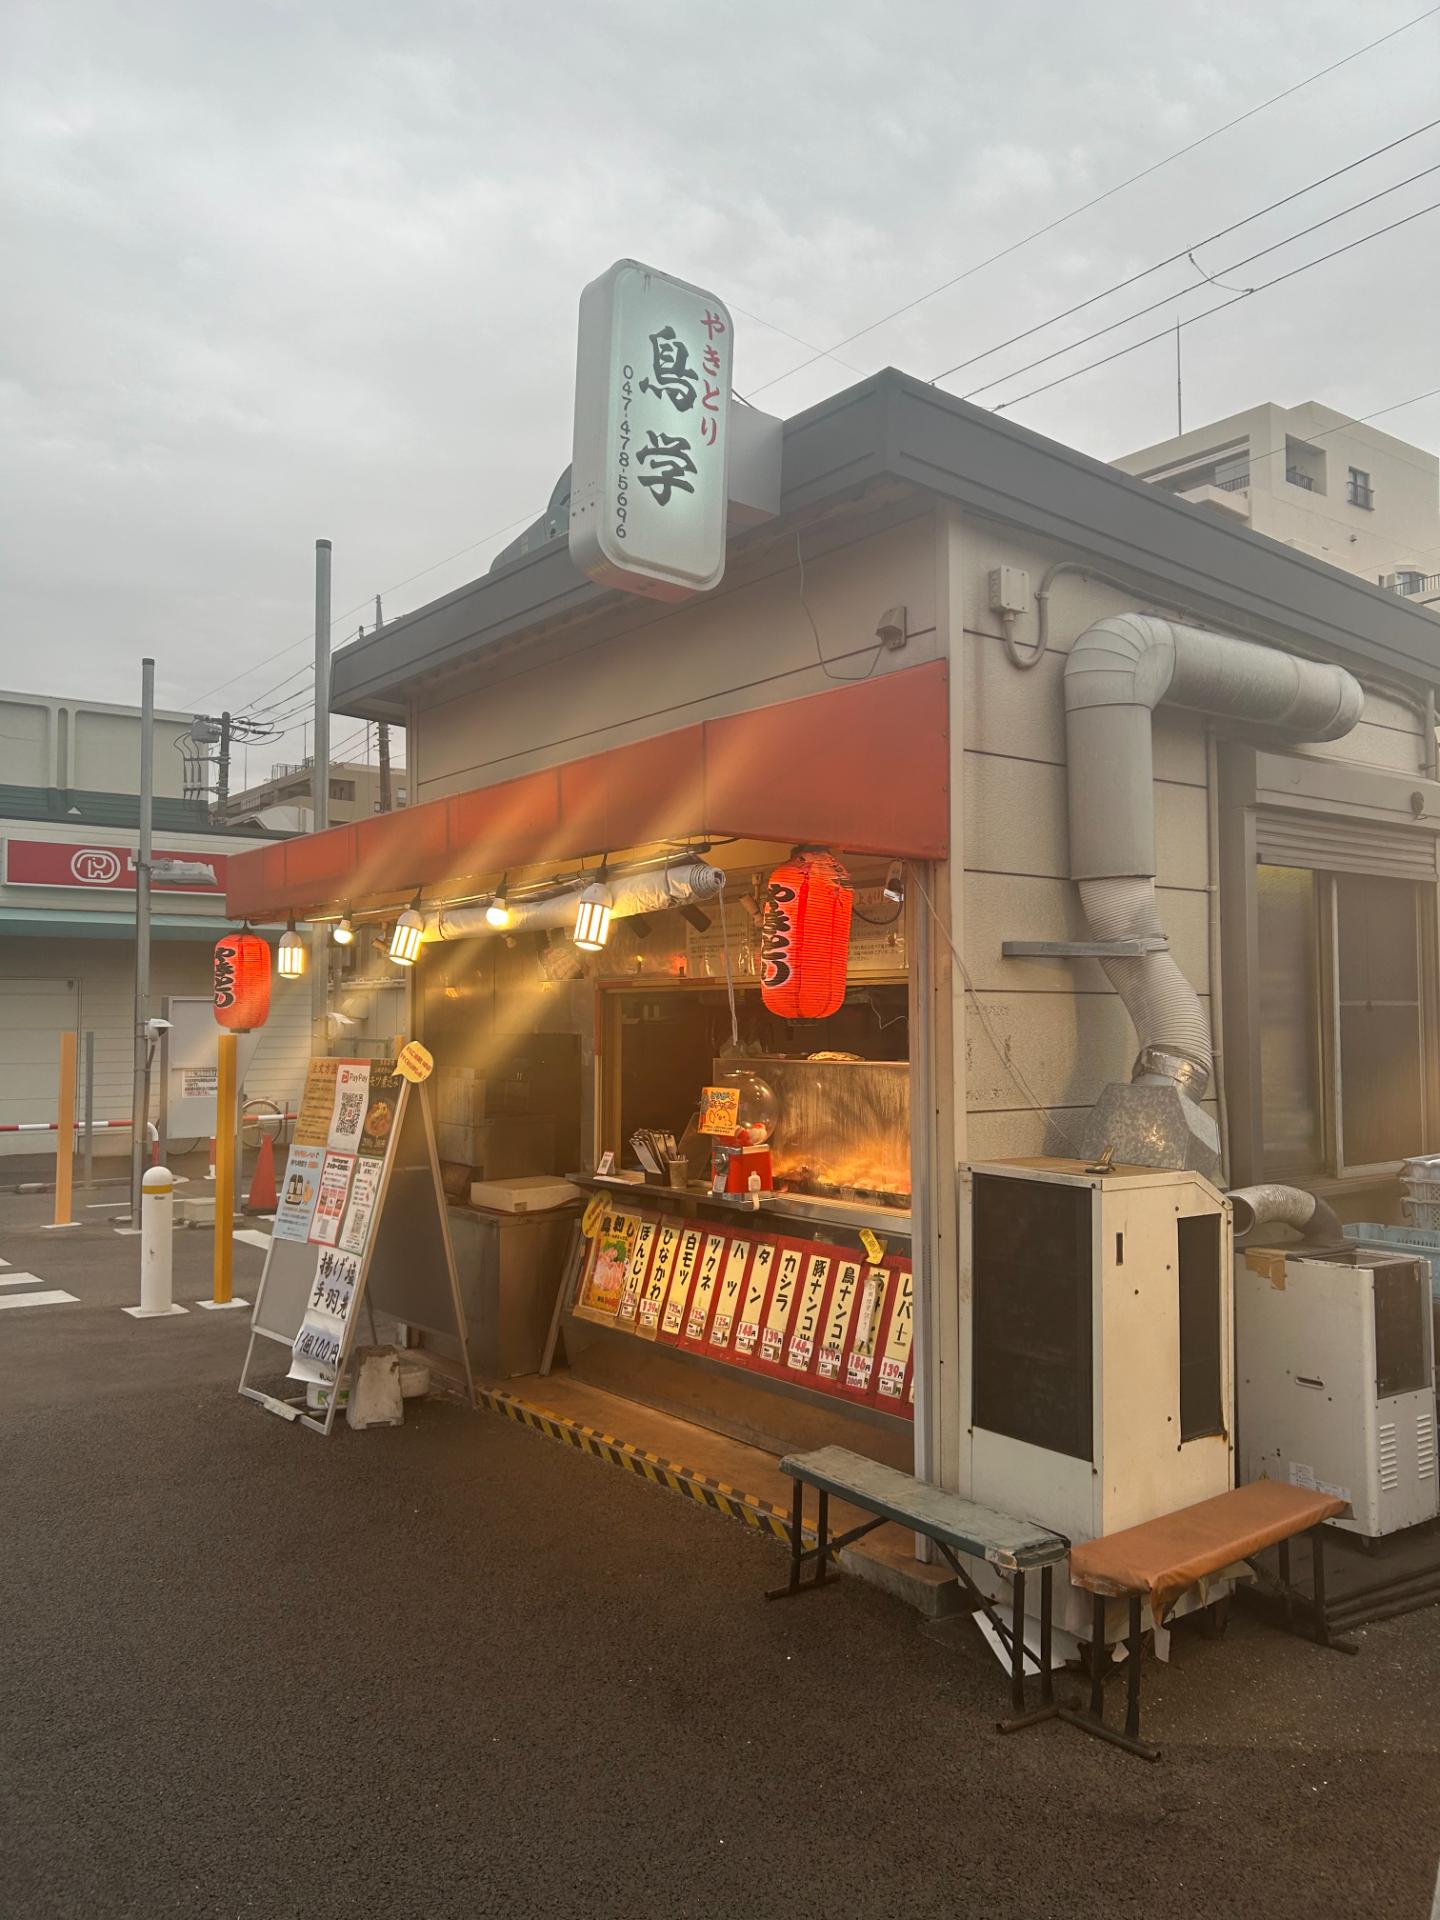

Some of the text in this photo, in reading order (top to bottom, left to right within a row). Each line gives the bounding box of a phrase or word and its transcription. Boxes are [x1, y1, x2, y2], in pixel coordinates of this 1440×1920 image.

[700, 309, 726, 446] やきとり
[615, 364, 634, 539] 047-478-5696
[762, 883, 796, 988] やきとり
[214, 946, 236, 1009] やきとり
[349, 1072, 368, 1084] PayPay
[650, 1229, 673, 1300] ひなかわ
[680, 1232, 697, 1286] 白モツ
[701, 1238, 721, 1291] ツクネ
[727, 1243, 744, 1297] ハツ
[750, 1248, 770, 1304] タン
[775, 1255, 796, 1312] カシラ
[764, 1329, 783, 1346] 139円
[789, 1337, 811, 1355] 148円
[849, 1354, 871, 1372] 186円
[882, 1361, 904, 1380] 139円
